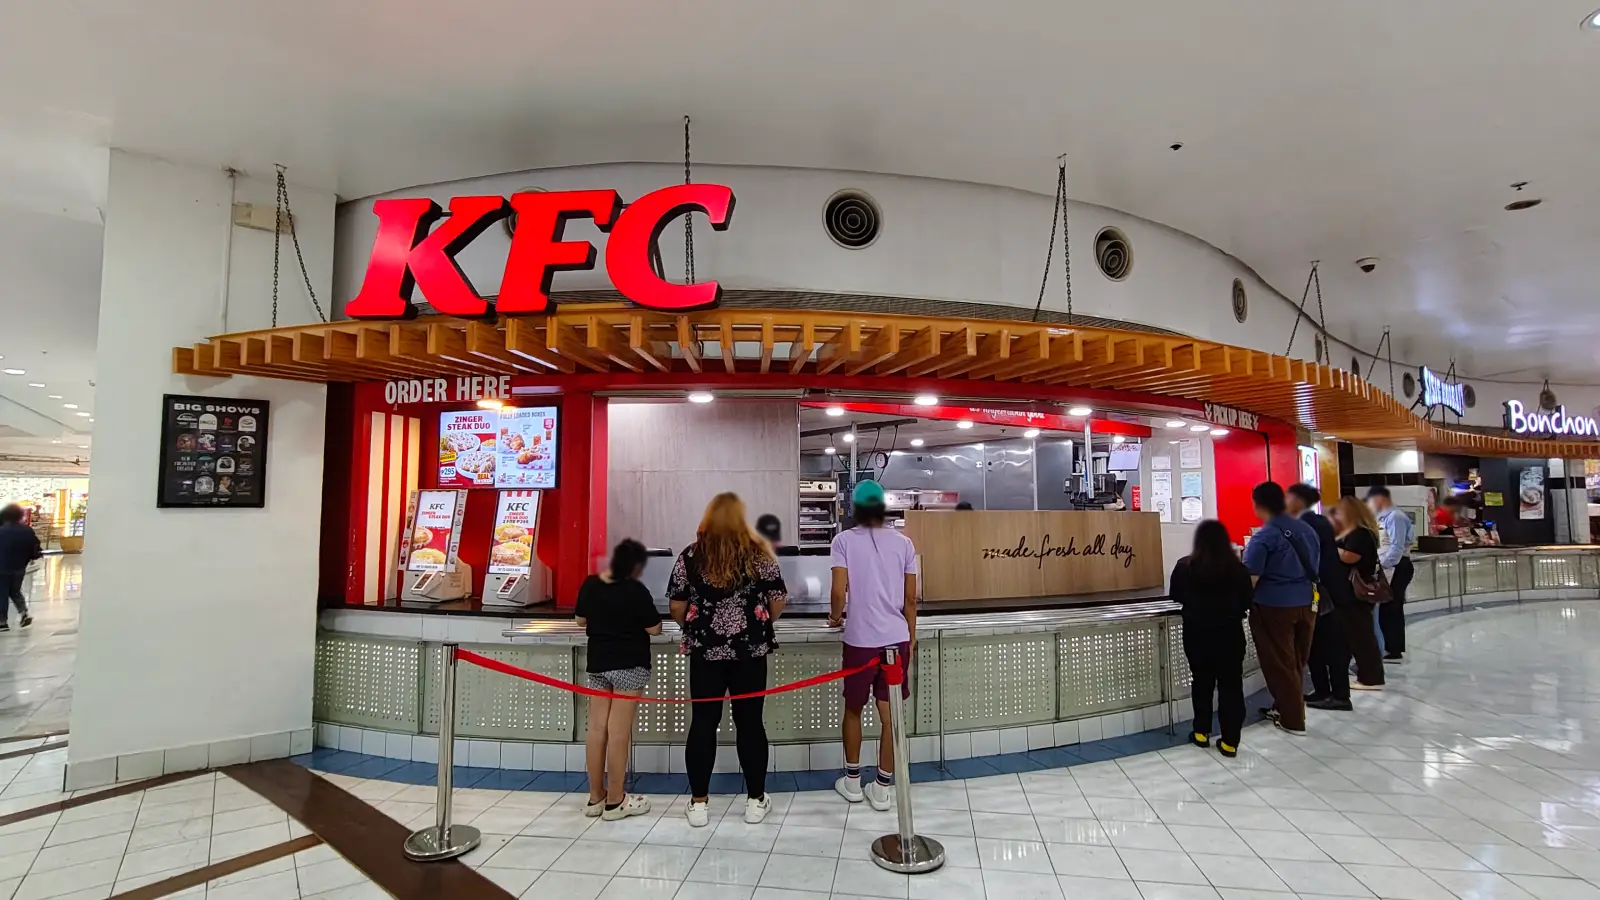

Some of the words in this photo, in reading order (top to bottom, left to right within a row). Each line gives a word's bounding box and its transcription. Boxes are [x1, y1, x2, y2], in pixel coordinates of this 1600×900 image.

[345, 183, 736, 319] KFC
[385, 379, 447, 404] ORDER
[456, 375, 511, 401] HERE
[174, 403, 202, 411] BIG
[205, 405, 260, 414] SHOWS
[1508, 399, 1599, 436] Bonchon
[447, 422, 473, 431] STEAK
[474, 422, 491, 430] DUO
[454, 415, 484, 424] ZINGER
[506, 502, 529, 512] KFC
[981, 536, 1034, 560] made
[1034, 534, 1080, 570] fresh
[1082, 534, 1106, 556] all
[1110, 533, 1137, 568] day
